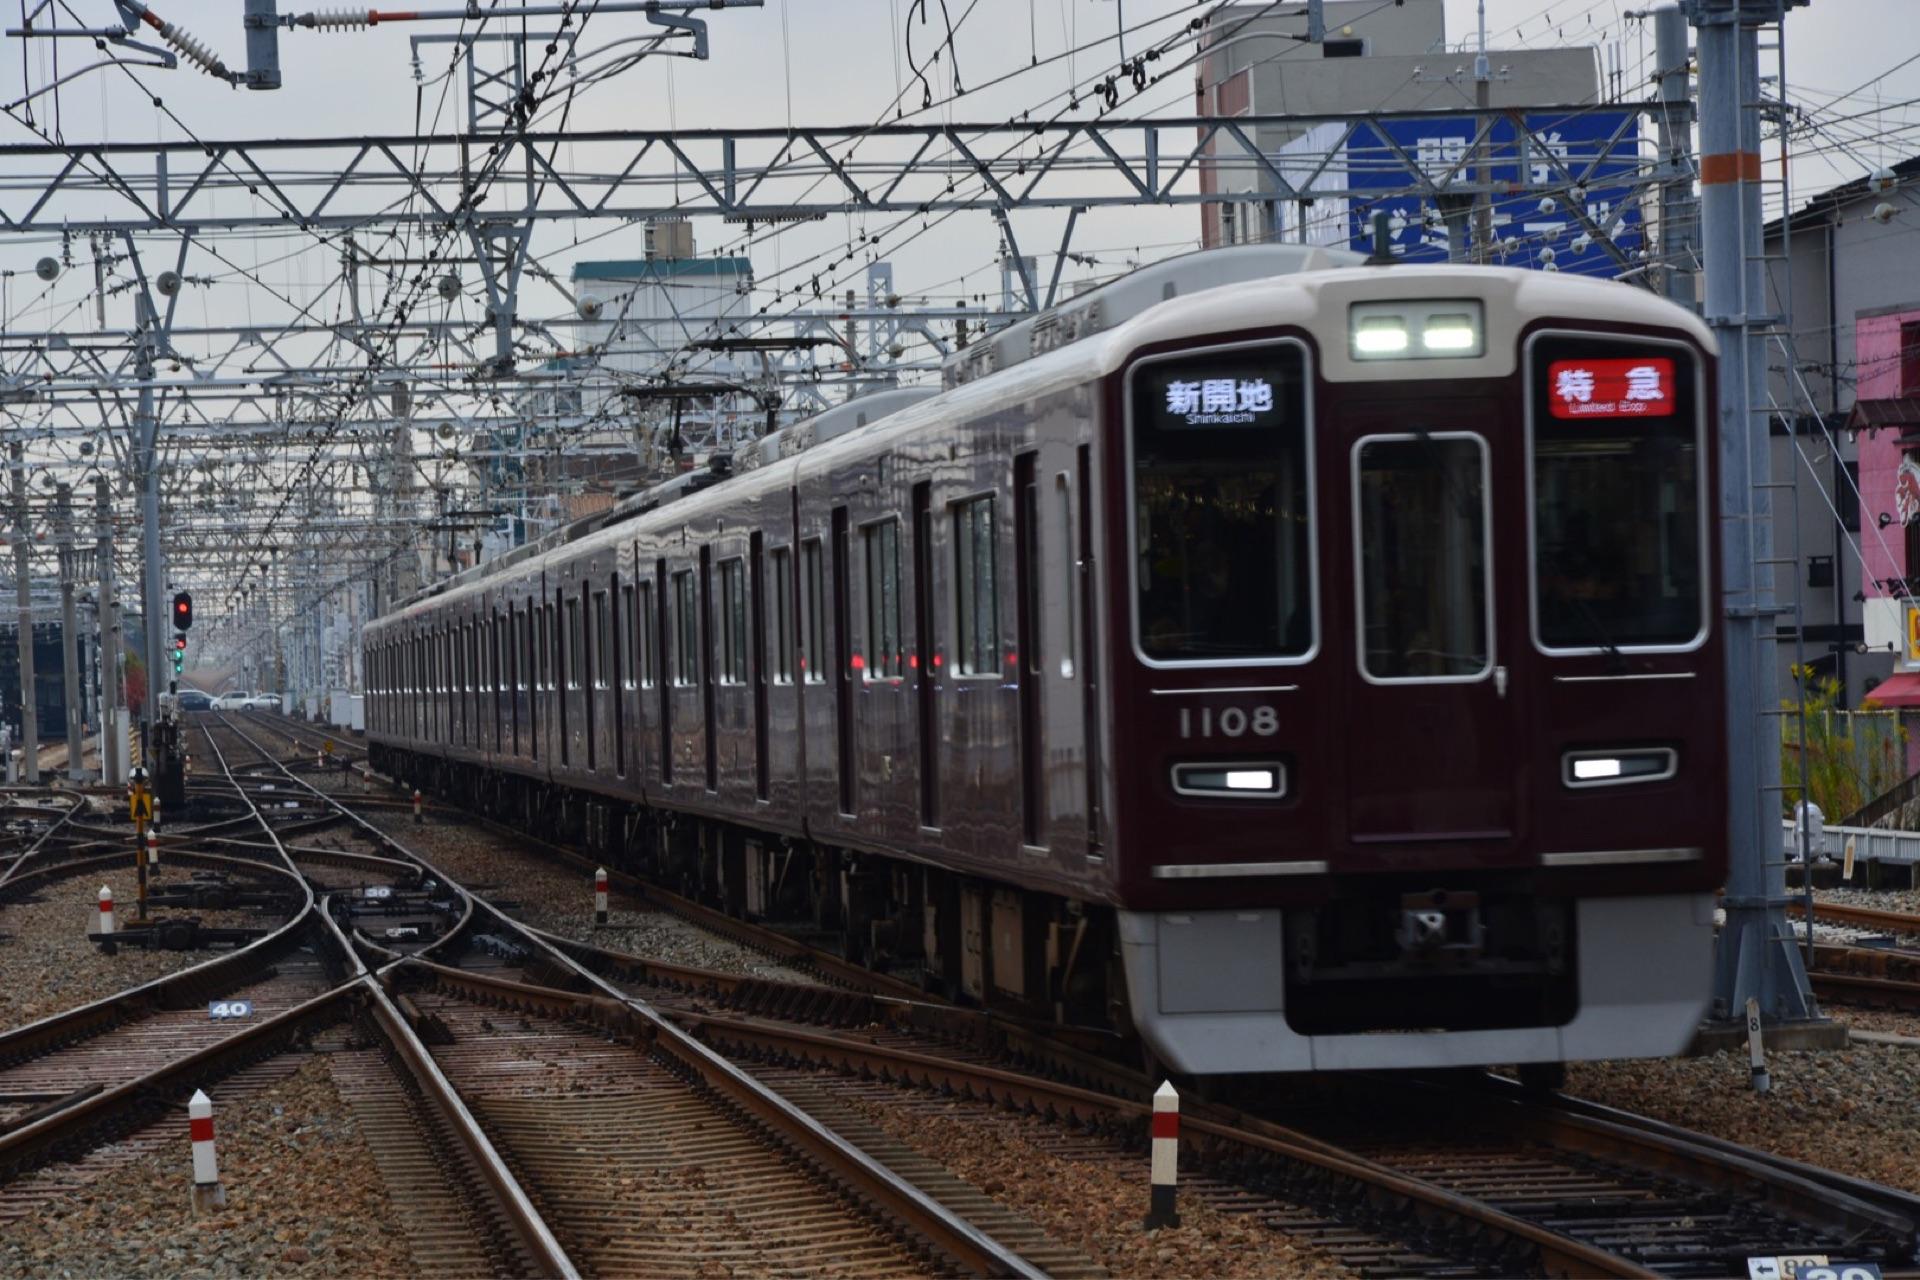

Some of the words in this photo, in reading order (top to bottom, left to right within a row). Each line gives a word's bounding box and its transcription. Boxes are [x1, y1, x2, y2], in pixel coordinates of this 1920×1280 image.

[1165, 379, 1273, 414] 新開地
[1180, 705, 1279, 738] 1108
[212, 1003, 248, 1017] 40
[1750, 1017, 1759, 1032] 8
